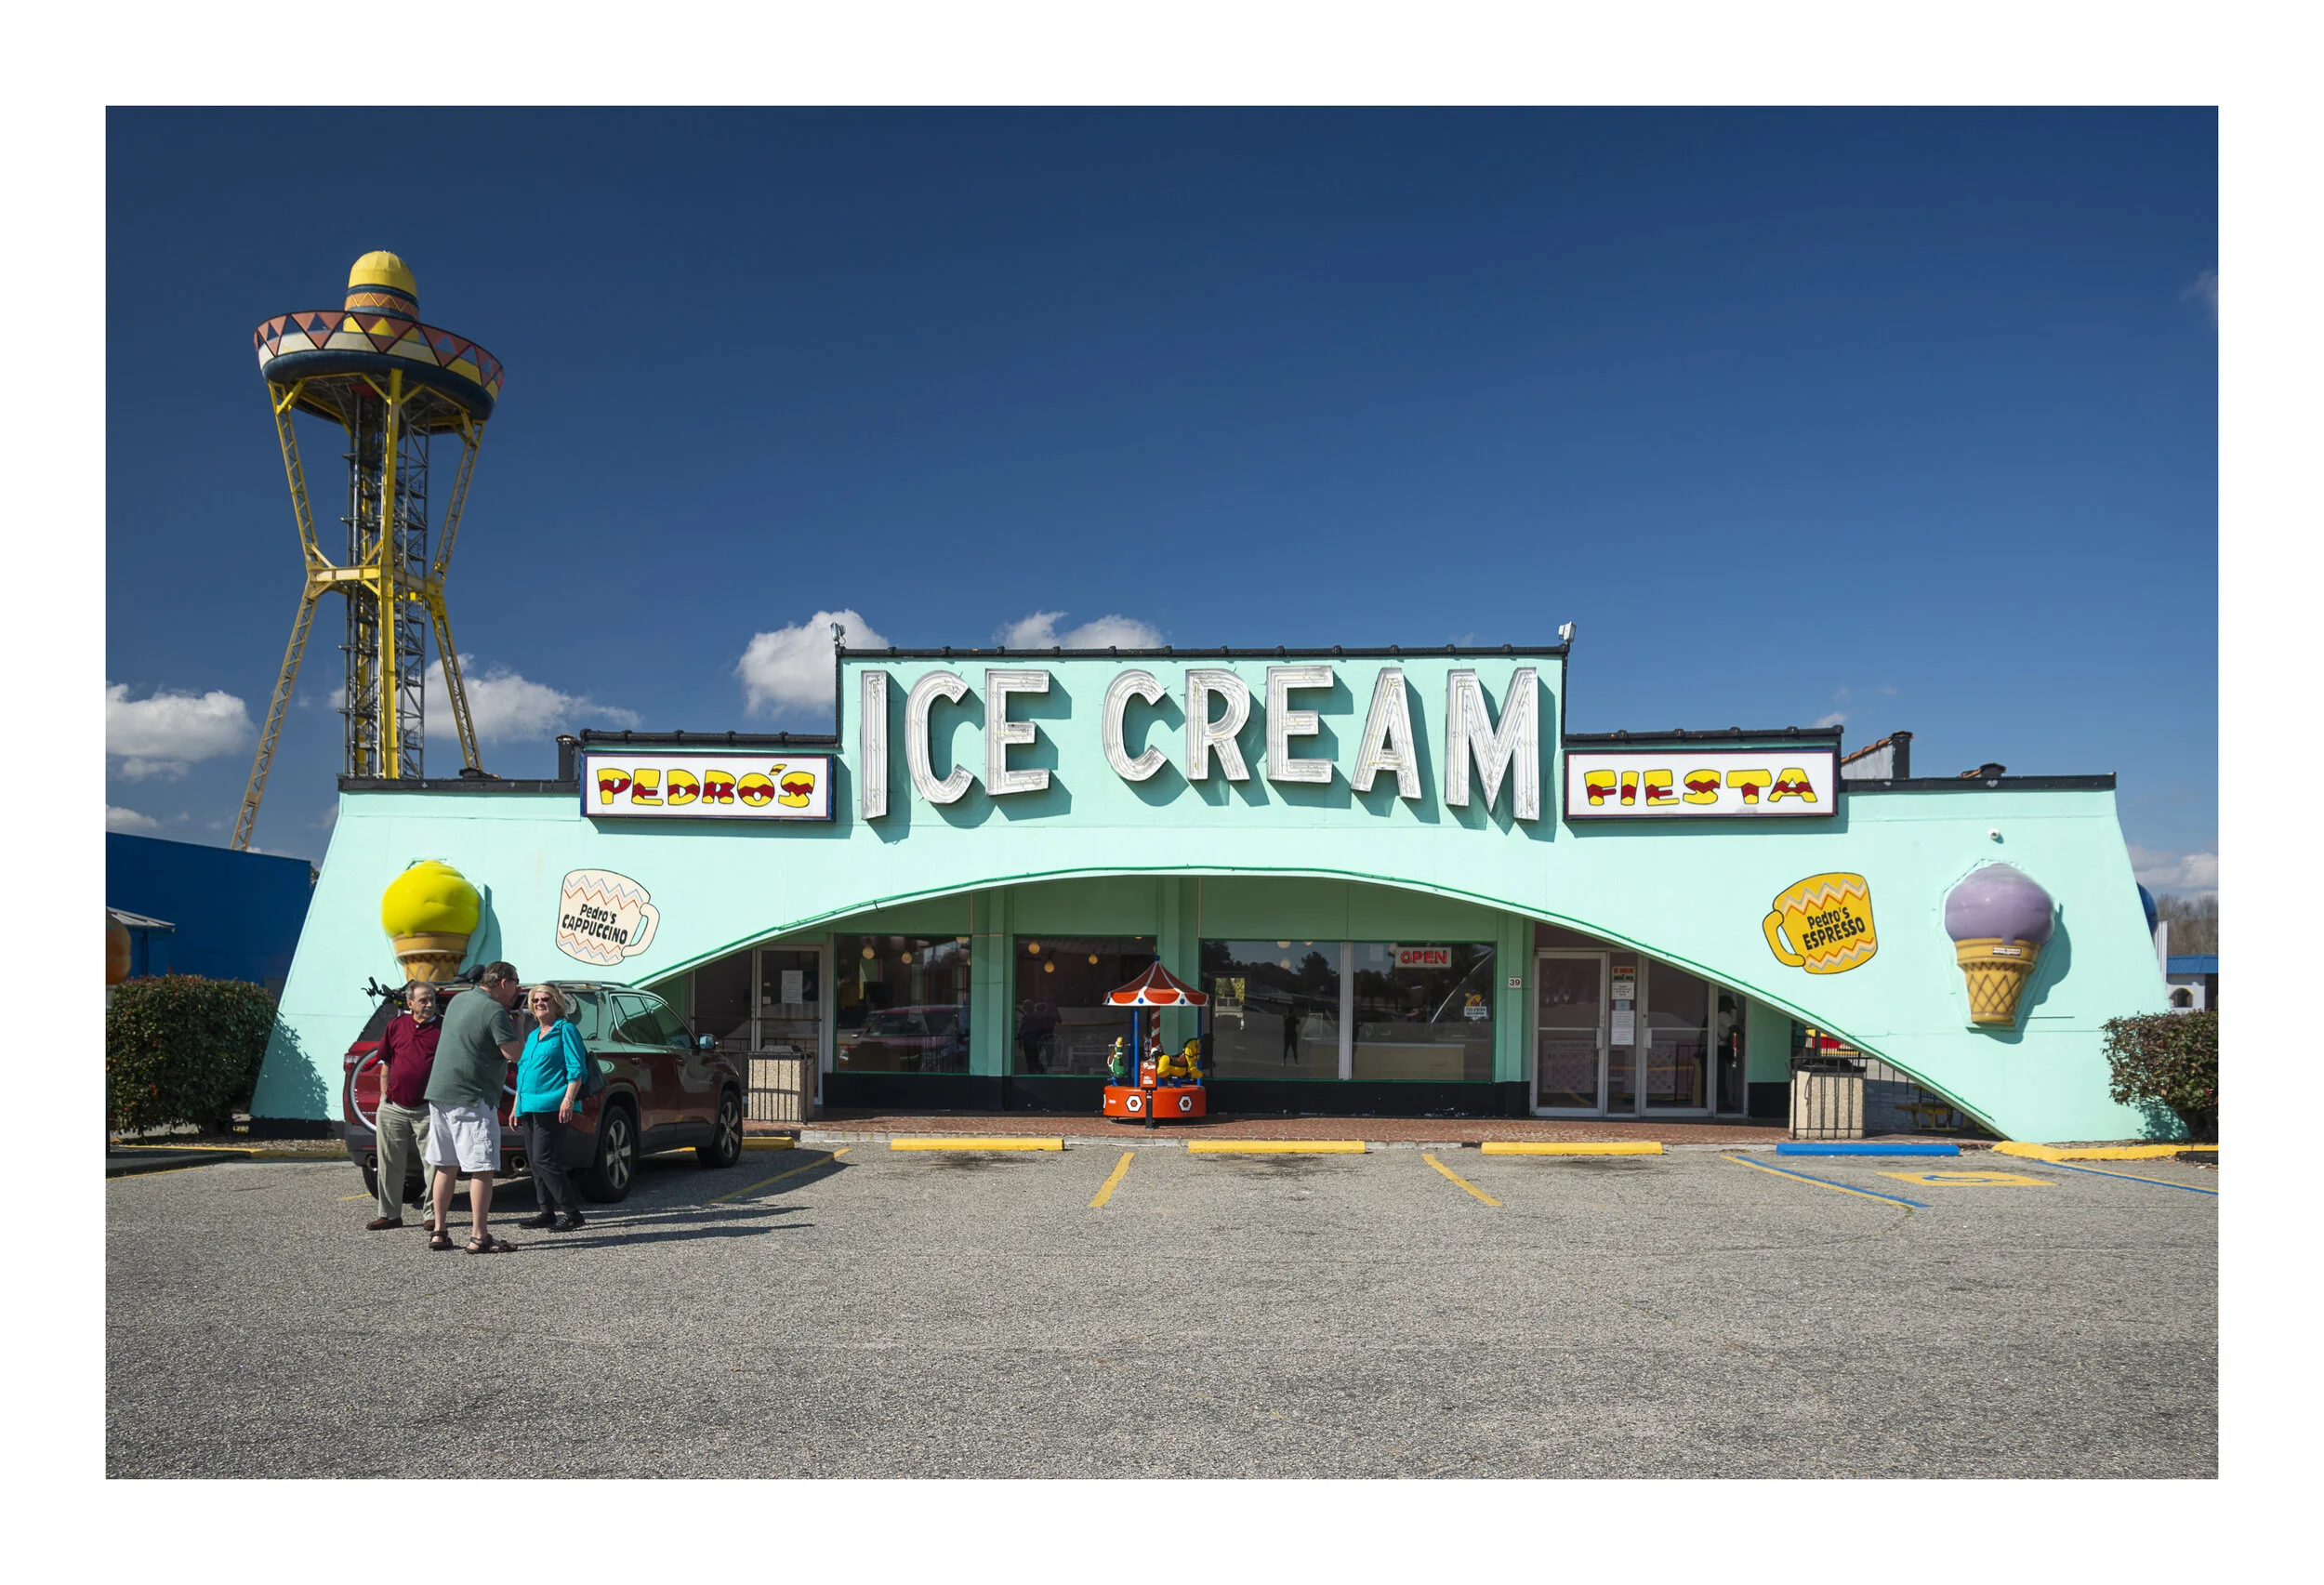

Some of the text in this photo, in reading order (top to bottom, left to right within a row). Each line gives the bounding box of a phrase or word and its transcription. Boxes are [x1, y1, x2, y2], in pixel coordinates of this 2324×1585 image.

[861, 666, 1539, 820] ICE CREAM
[596, 763, 816, 808] PEDRO'S
[1583, 767, 1818, 807] FIESTA
[561, 913, 628, 945] CAPPUCCINO
[579, 903, 617, 925] Pedro's
[1806, 906, 1851, 930] Pedro's
[1802, 916, 1866, 951] ESPRESSO
[1400, 950, 1447, 964] OPEN
